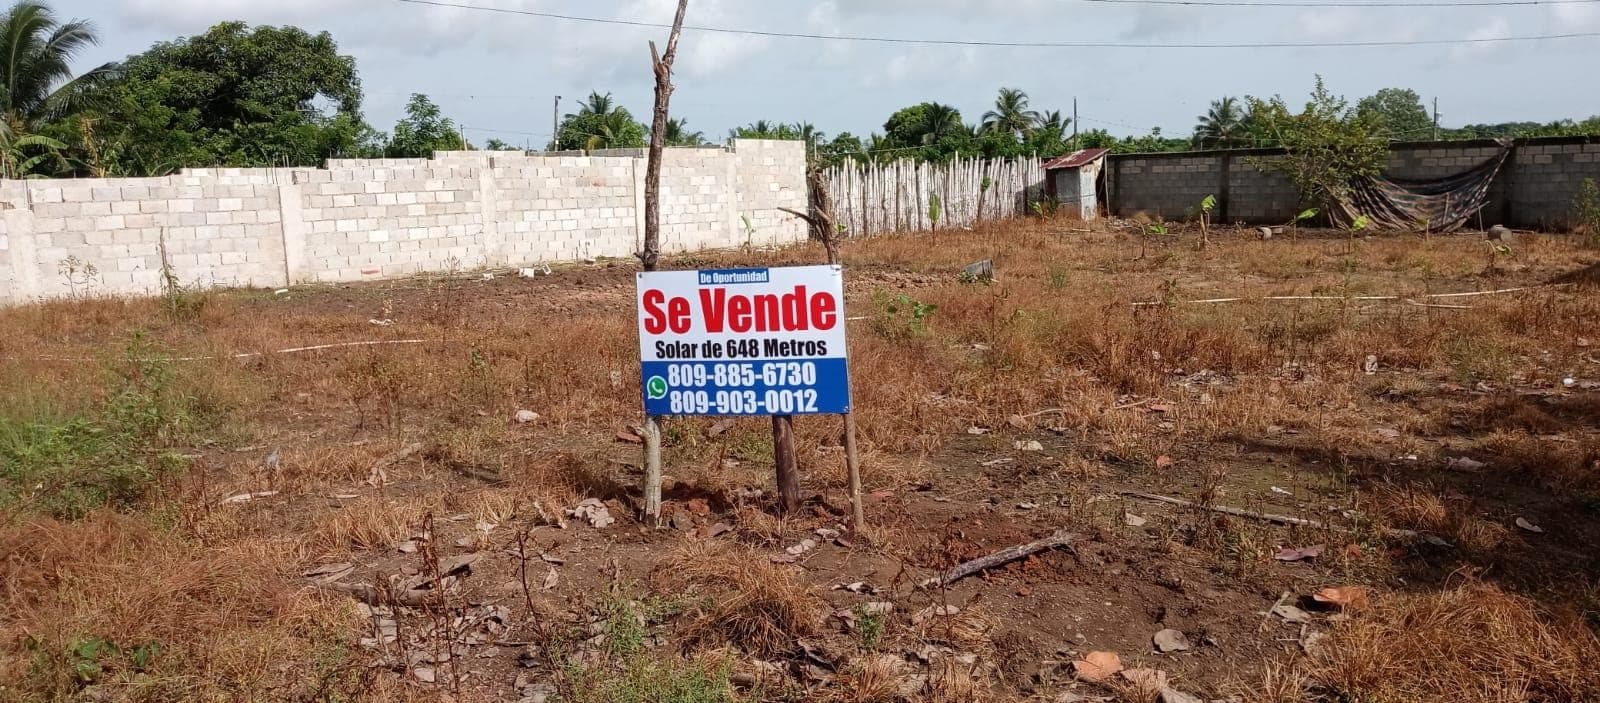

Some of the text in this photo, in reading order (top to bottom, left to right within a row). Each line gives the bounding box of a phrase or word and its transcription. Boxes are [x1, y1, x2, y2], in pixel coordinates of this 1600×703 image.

[700, 271, 768, 284] De Oportunidad
[642, 285, 837, 335] Se Vende
[655, 338, 828, 359] Solar de 648 Metros
[667, 361, 817, 387] 809-885-6730
[669, 388, 819, 414] 809-903-0012
